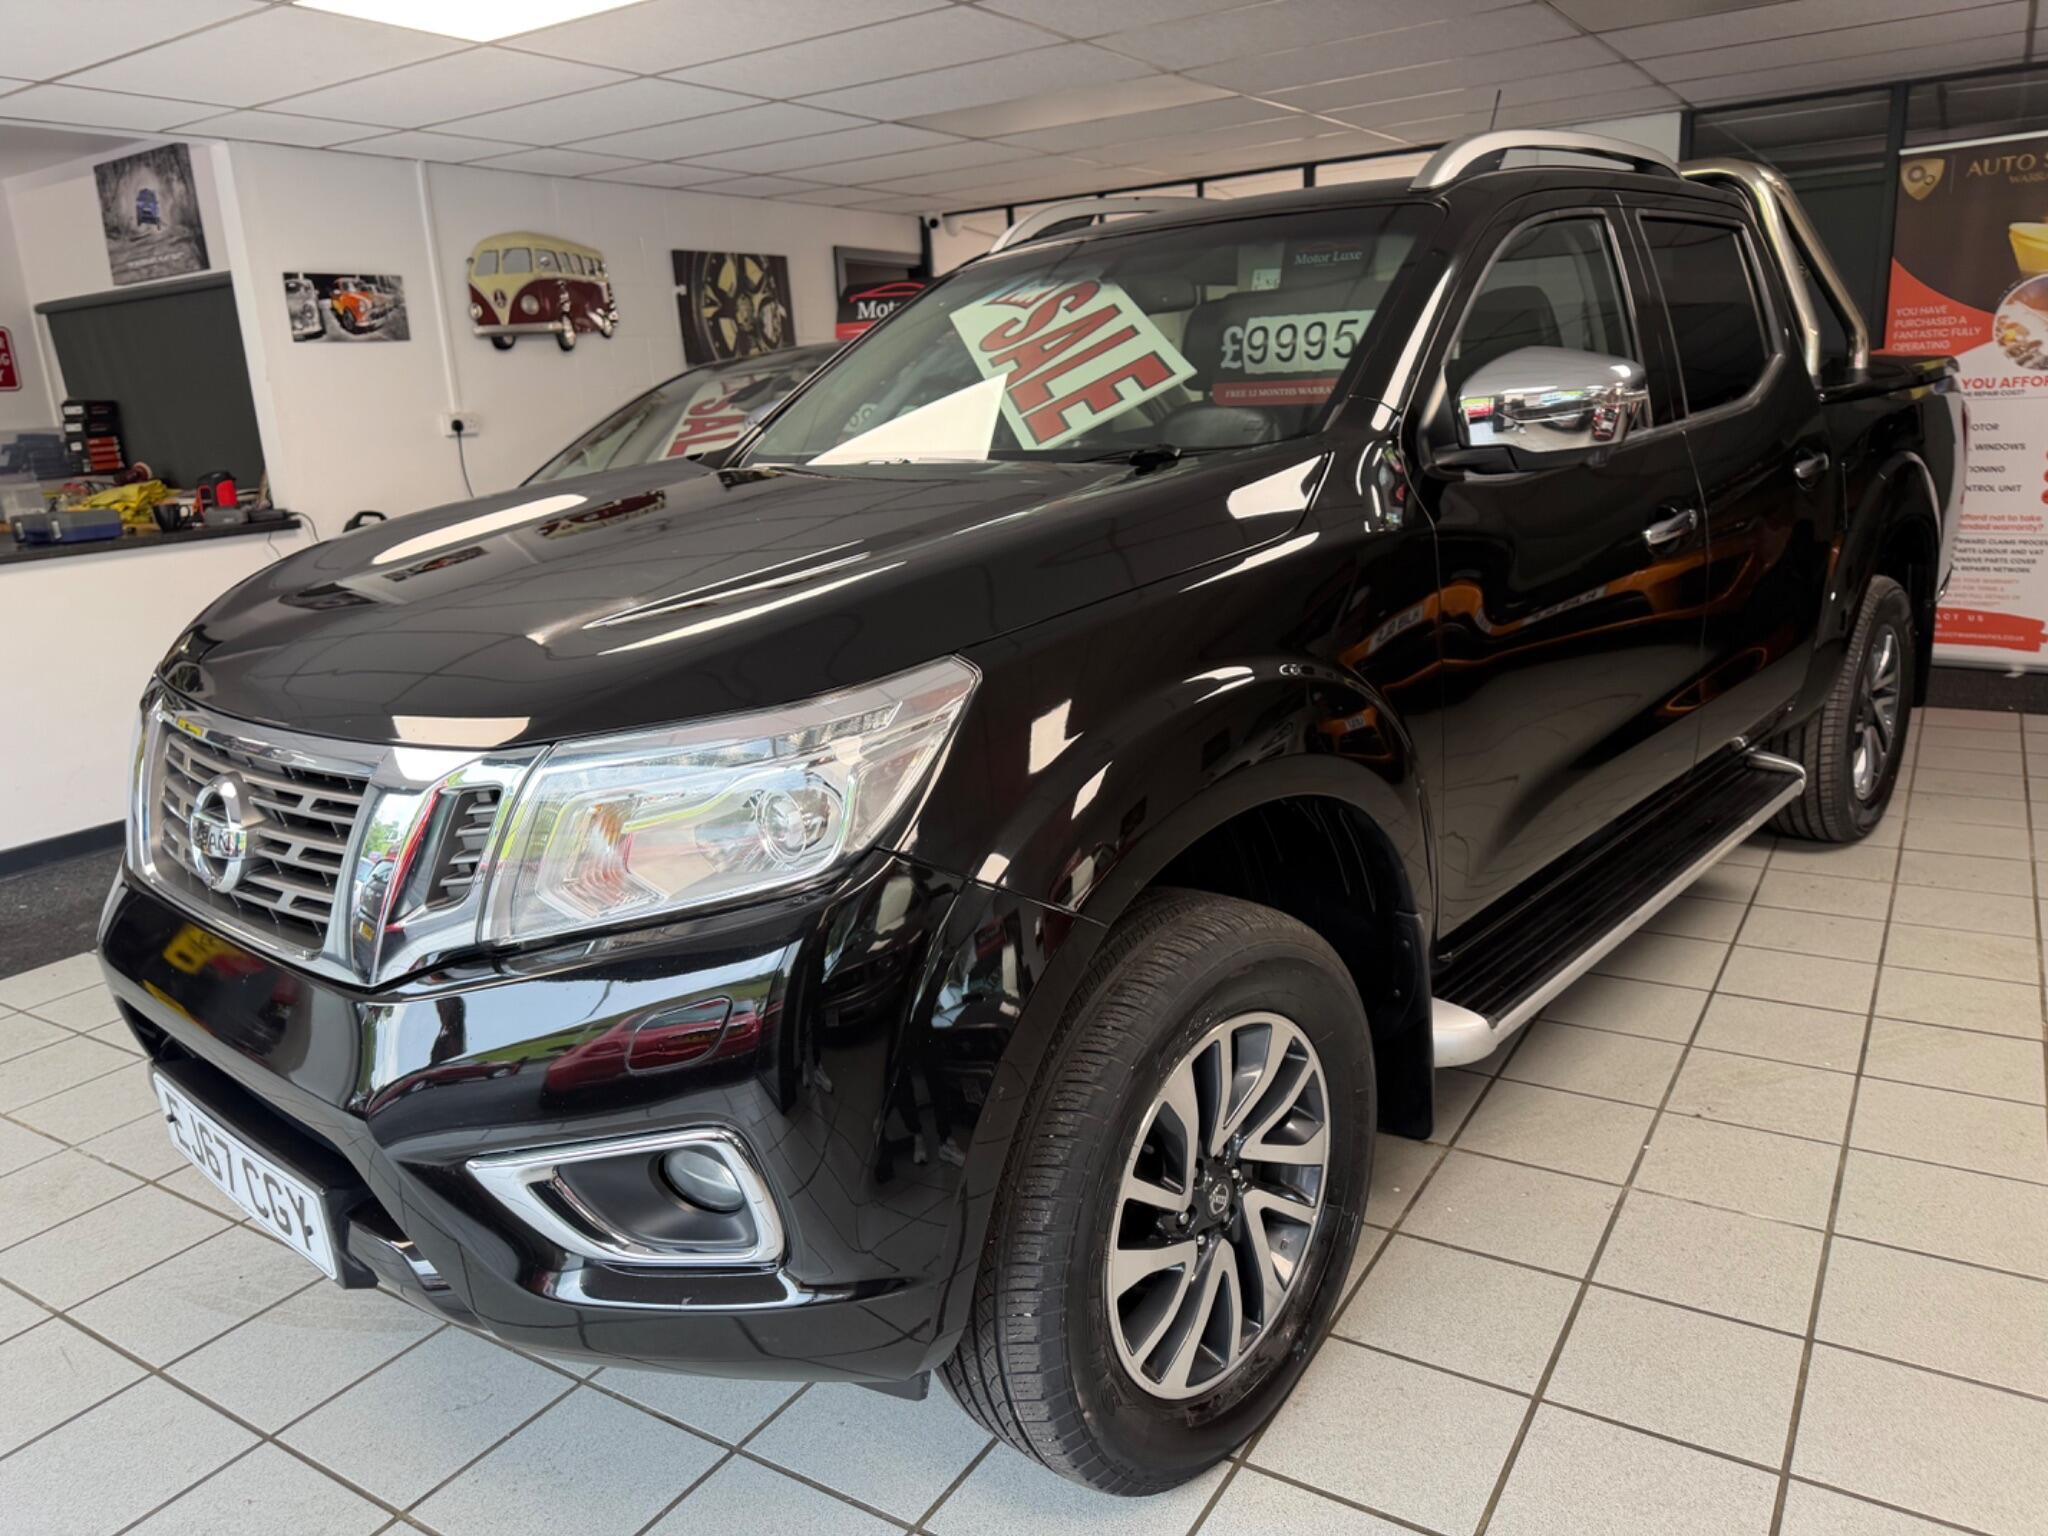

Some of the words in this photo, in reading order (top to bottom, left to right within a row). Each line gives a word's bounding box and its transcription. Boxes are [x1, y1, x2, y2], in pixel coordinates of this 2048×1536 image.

[1966, 153, 2036, 178] AUTO
[857, 300, 896, 320] Mot
[1896, 307, 1918, 317] YOU
[1920, 305, 1948, 315] HAVE
[1894, 317, 1957, 328] PURCHASED
[1893, 328, 1950, 340] FANTASTIC
[1951, 326, 1982, 338] FULLY
[1892, 340, 1951, 352] OPERATING
[979, 279, 1176, 446] SALE
[1961, 378, 1996, 390] YOU
[1969, 423, 2000, 432] OTOR
[165, 1090, 236, 1194] EJ67
[241, 1156, 313, 1253] CGY
